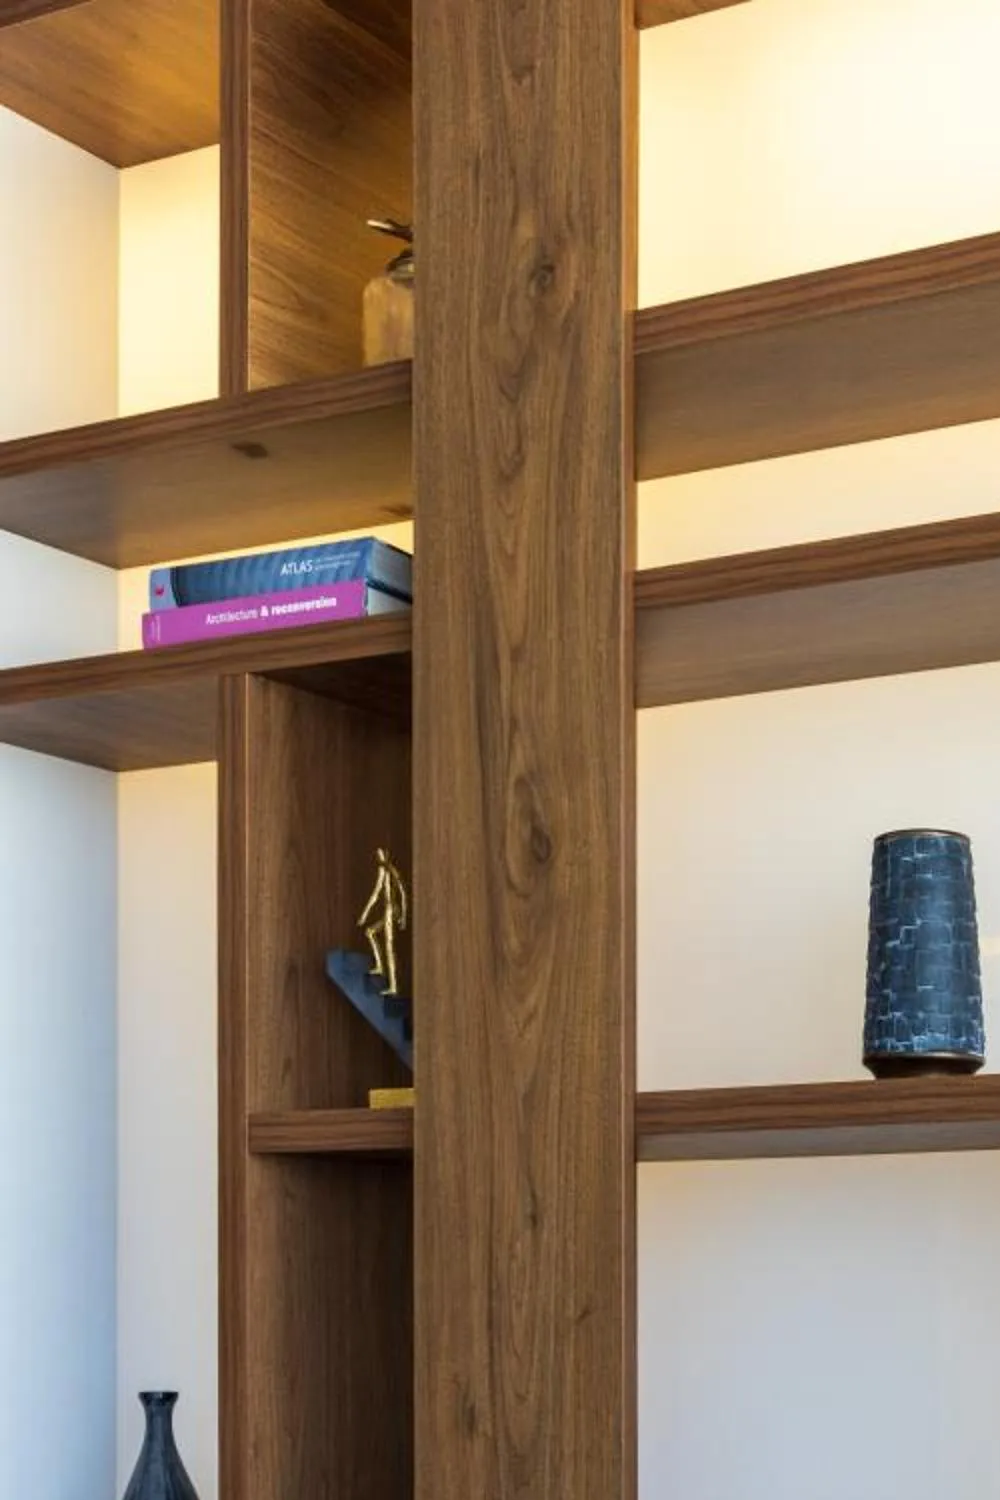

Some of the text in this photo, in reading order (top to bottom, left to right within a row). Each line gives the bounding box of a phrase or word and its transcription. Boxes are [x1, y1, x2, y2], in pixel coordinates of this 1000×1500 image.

[280, 559, 313, 577] ATLAS
[205, 608, 258, 625] Architecture
[260, 605, 269, 617] &
